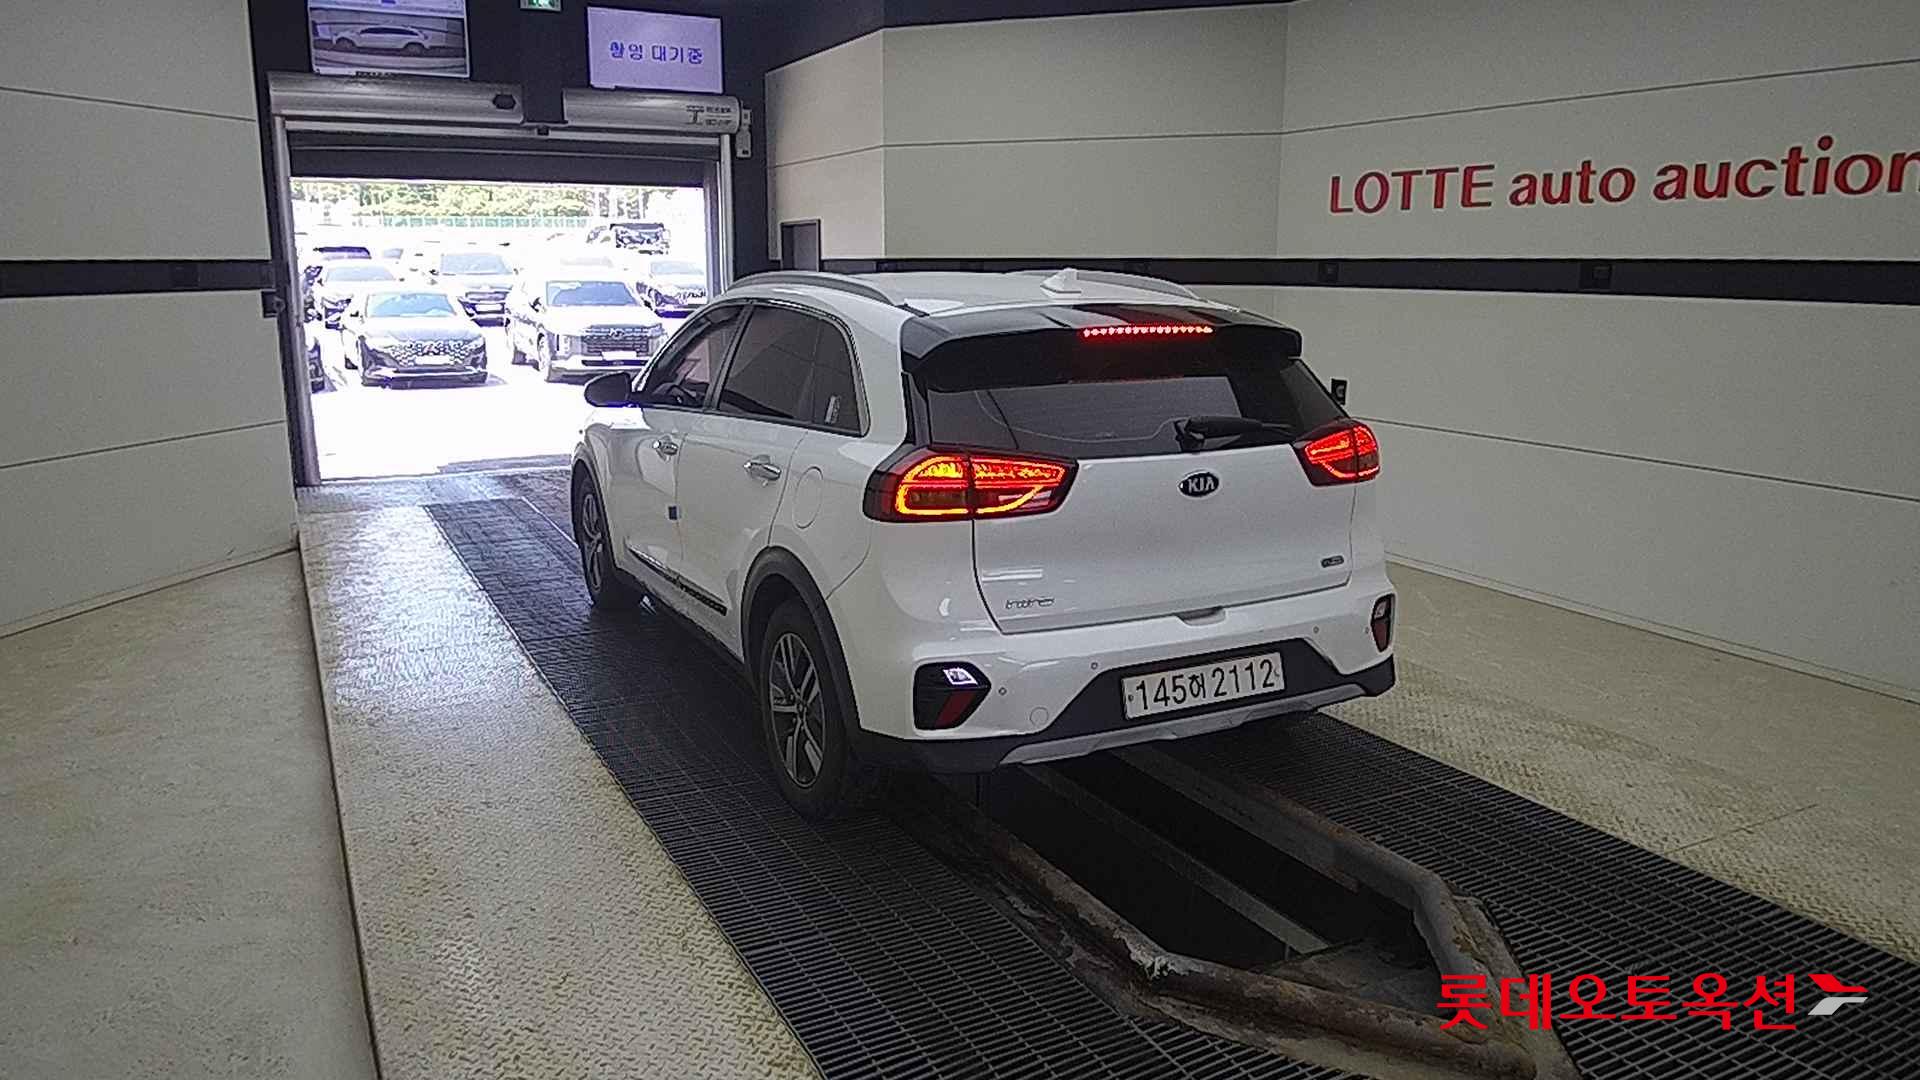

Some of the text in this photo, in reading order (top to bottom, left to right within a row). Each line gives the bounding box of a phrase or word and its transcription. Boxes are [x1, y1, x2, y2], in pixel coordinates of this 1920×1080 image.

[651, 45, 703, 65] 대기중
[1330, 135, 1920, 213] LOTTE auto auction
[1188, 476, 1215, 493] KIA
